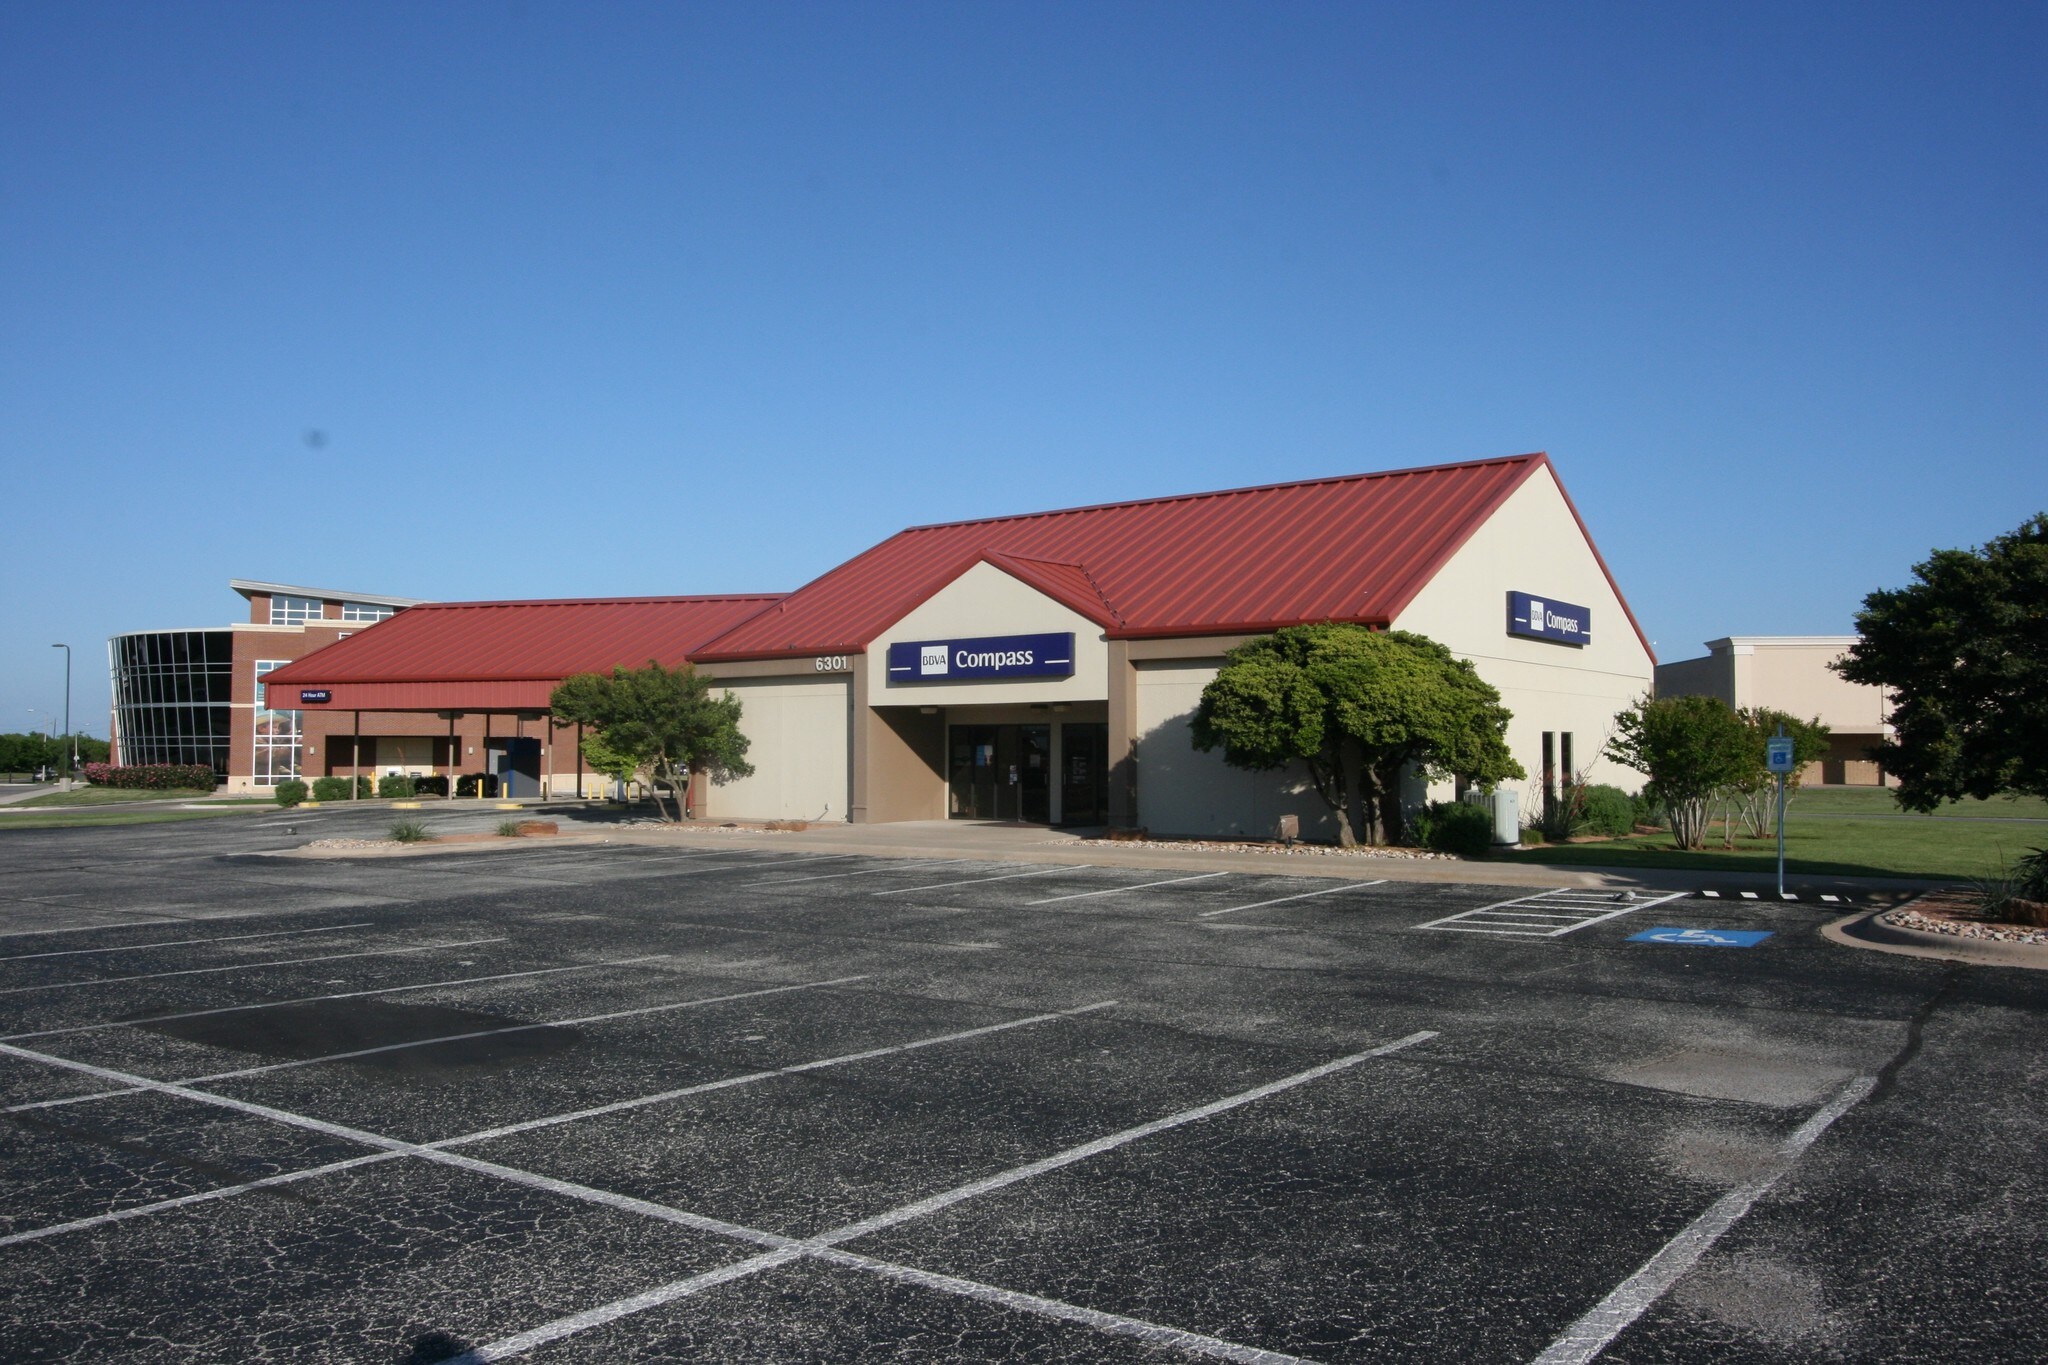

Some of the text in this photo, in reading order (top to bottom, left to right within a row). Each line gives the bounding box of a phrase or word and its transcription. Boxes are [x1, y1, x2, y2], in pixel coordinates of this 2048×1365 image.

[1546, 610, 1578, 634] Compass
[815, 656, 847, 671] 6301
[922, 650, 1033, 670] BBVA Compass
